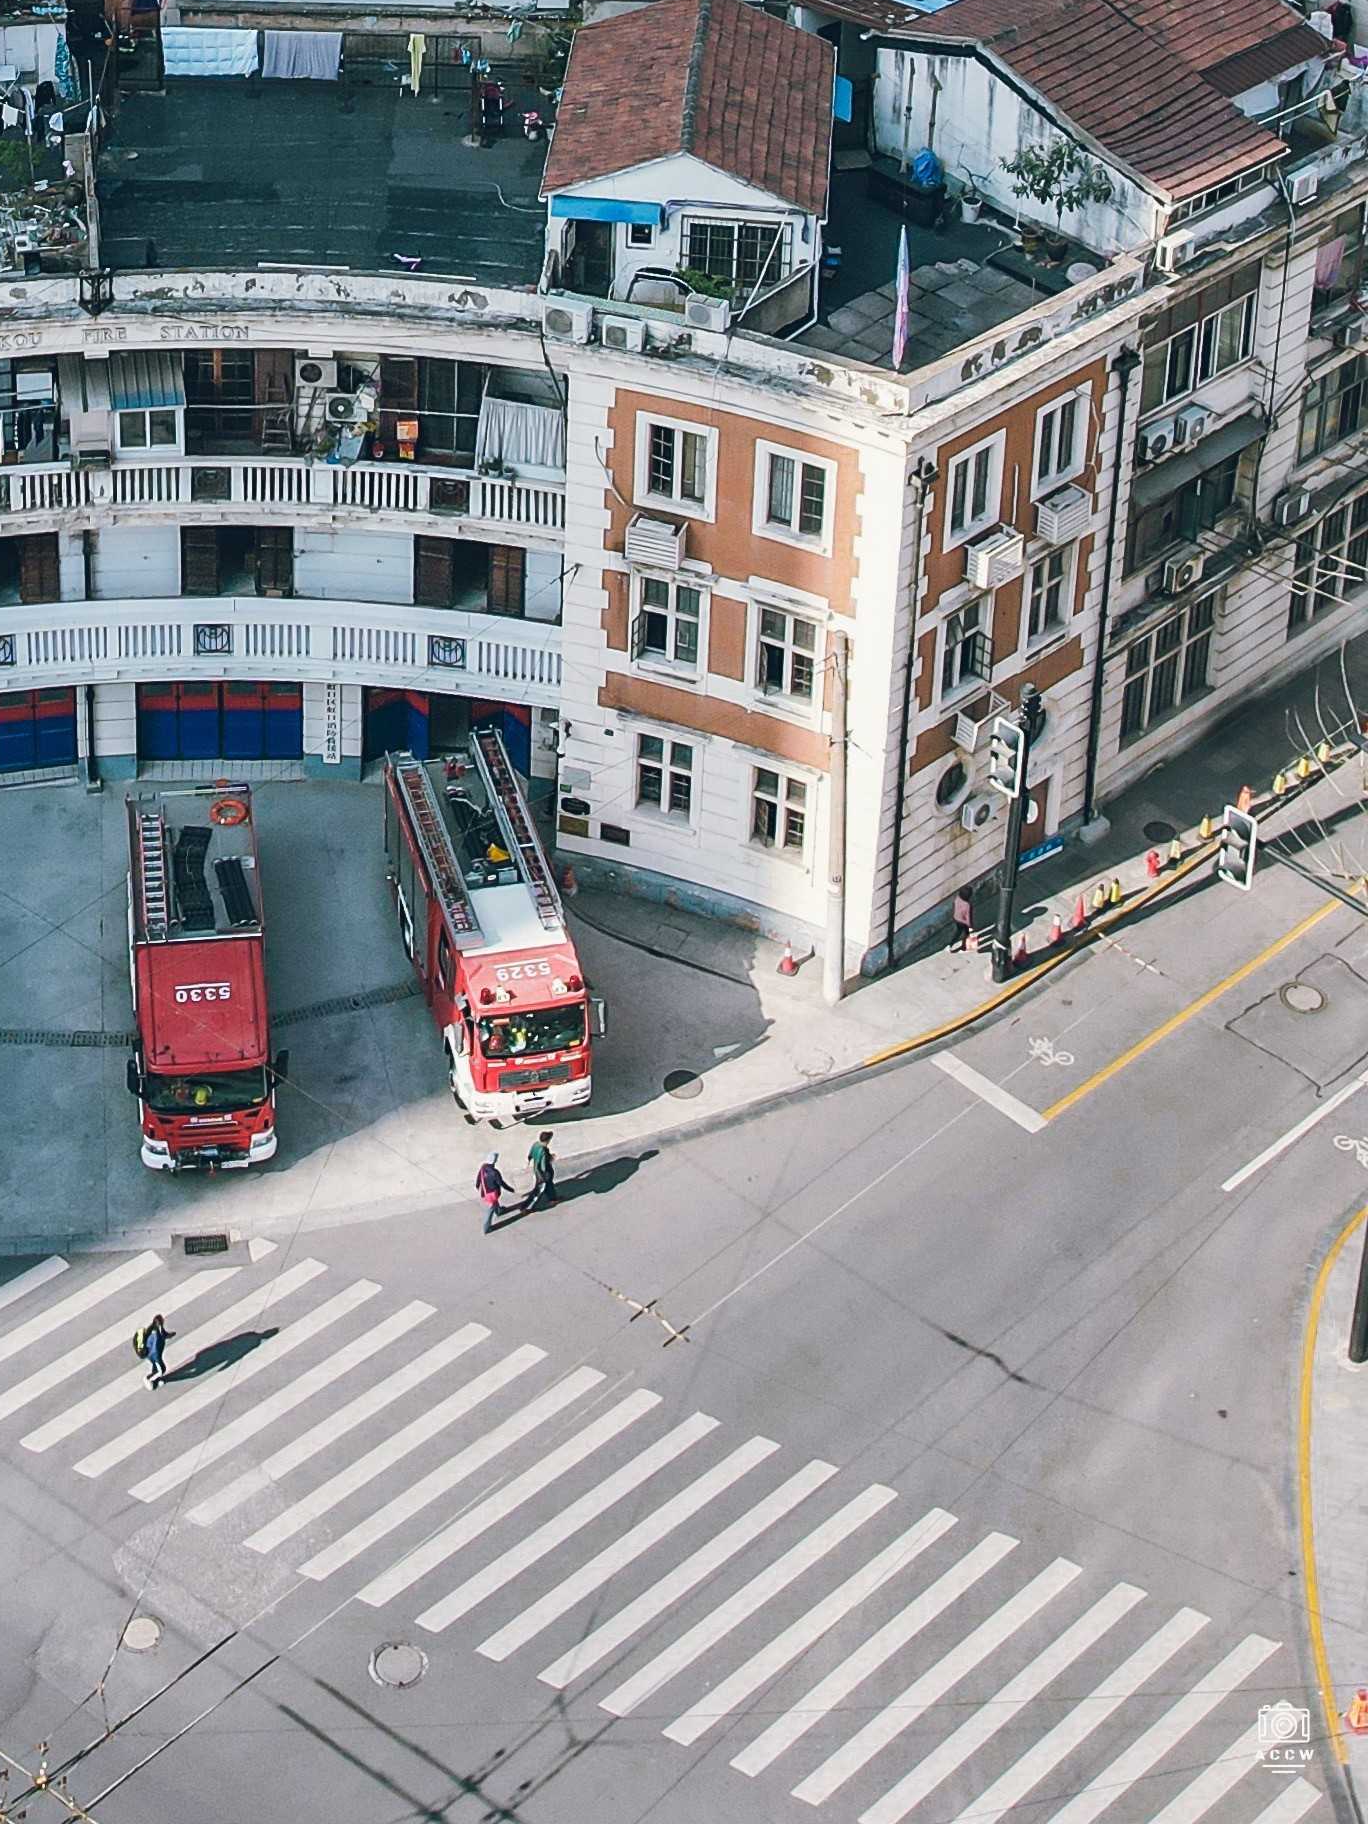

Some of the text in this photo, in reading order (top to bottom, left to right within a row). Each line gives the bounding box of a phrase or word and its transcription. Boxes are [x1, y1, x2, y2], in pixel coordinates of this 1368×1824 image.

[81, 326, 128, 345] FIRE
[159, 324, 250, 340] STATION
[495, 962, 552, 982] 5329
[175, 986, 231, 1004] 5330
